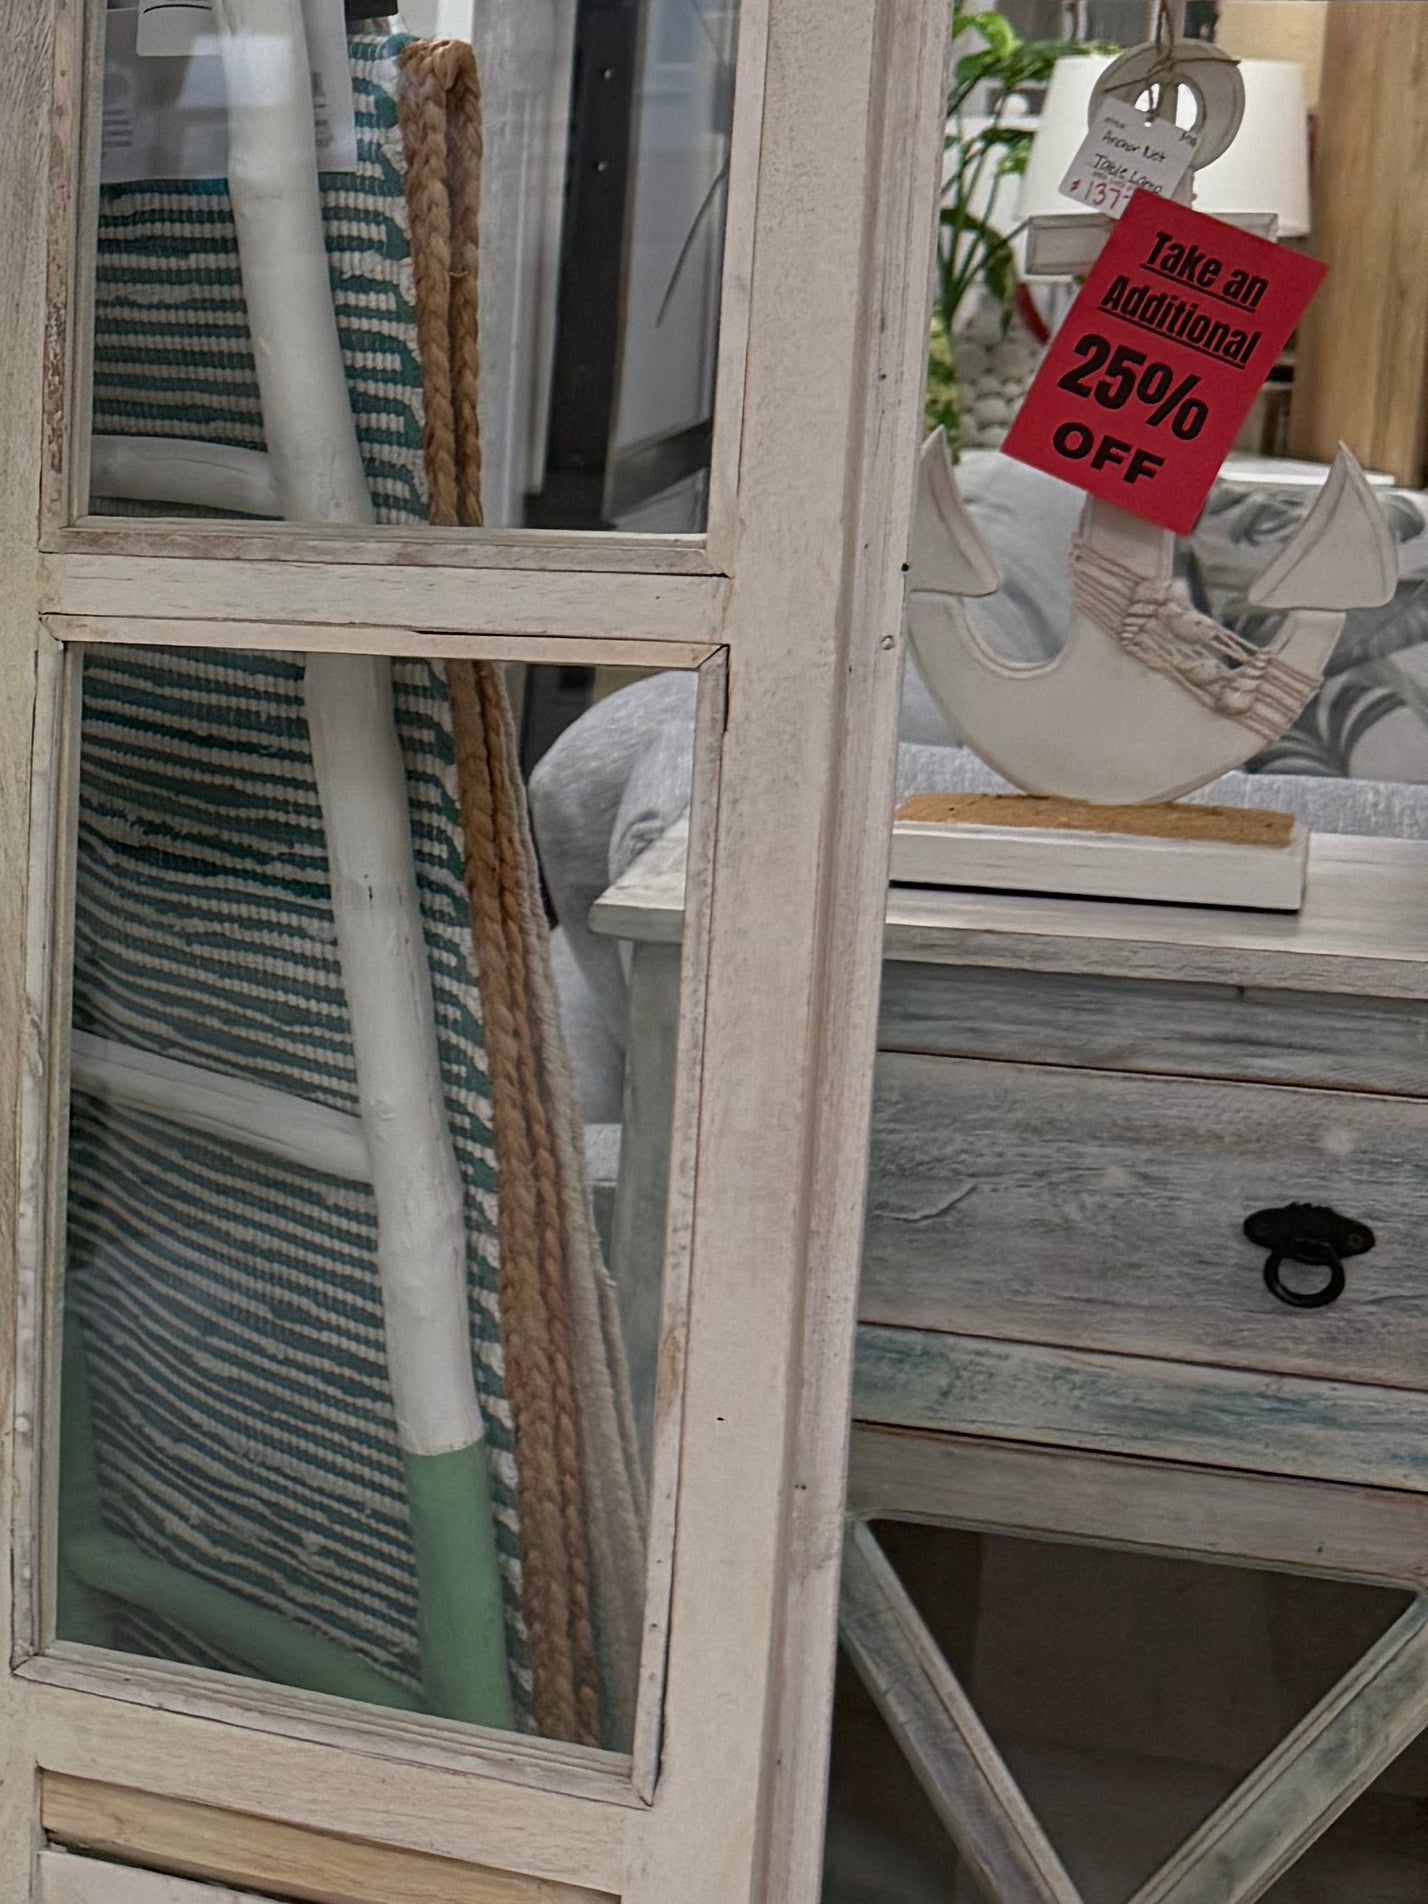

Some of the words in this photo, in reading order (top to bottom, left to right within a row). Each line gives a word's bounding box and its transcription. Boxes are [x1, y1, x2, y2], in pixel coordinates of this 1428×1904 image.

[1147, 231, 1223, 289] Take
[1222, 267, 1269, 308] an
[1100, 274, 1262, 364] Additional
[1057, 333, 1209, 441] 25%
[1052, 421, 1165, 484] OFF
